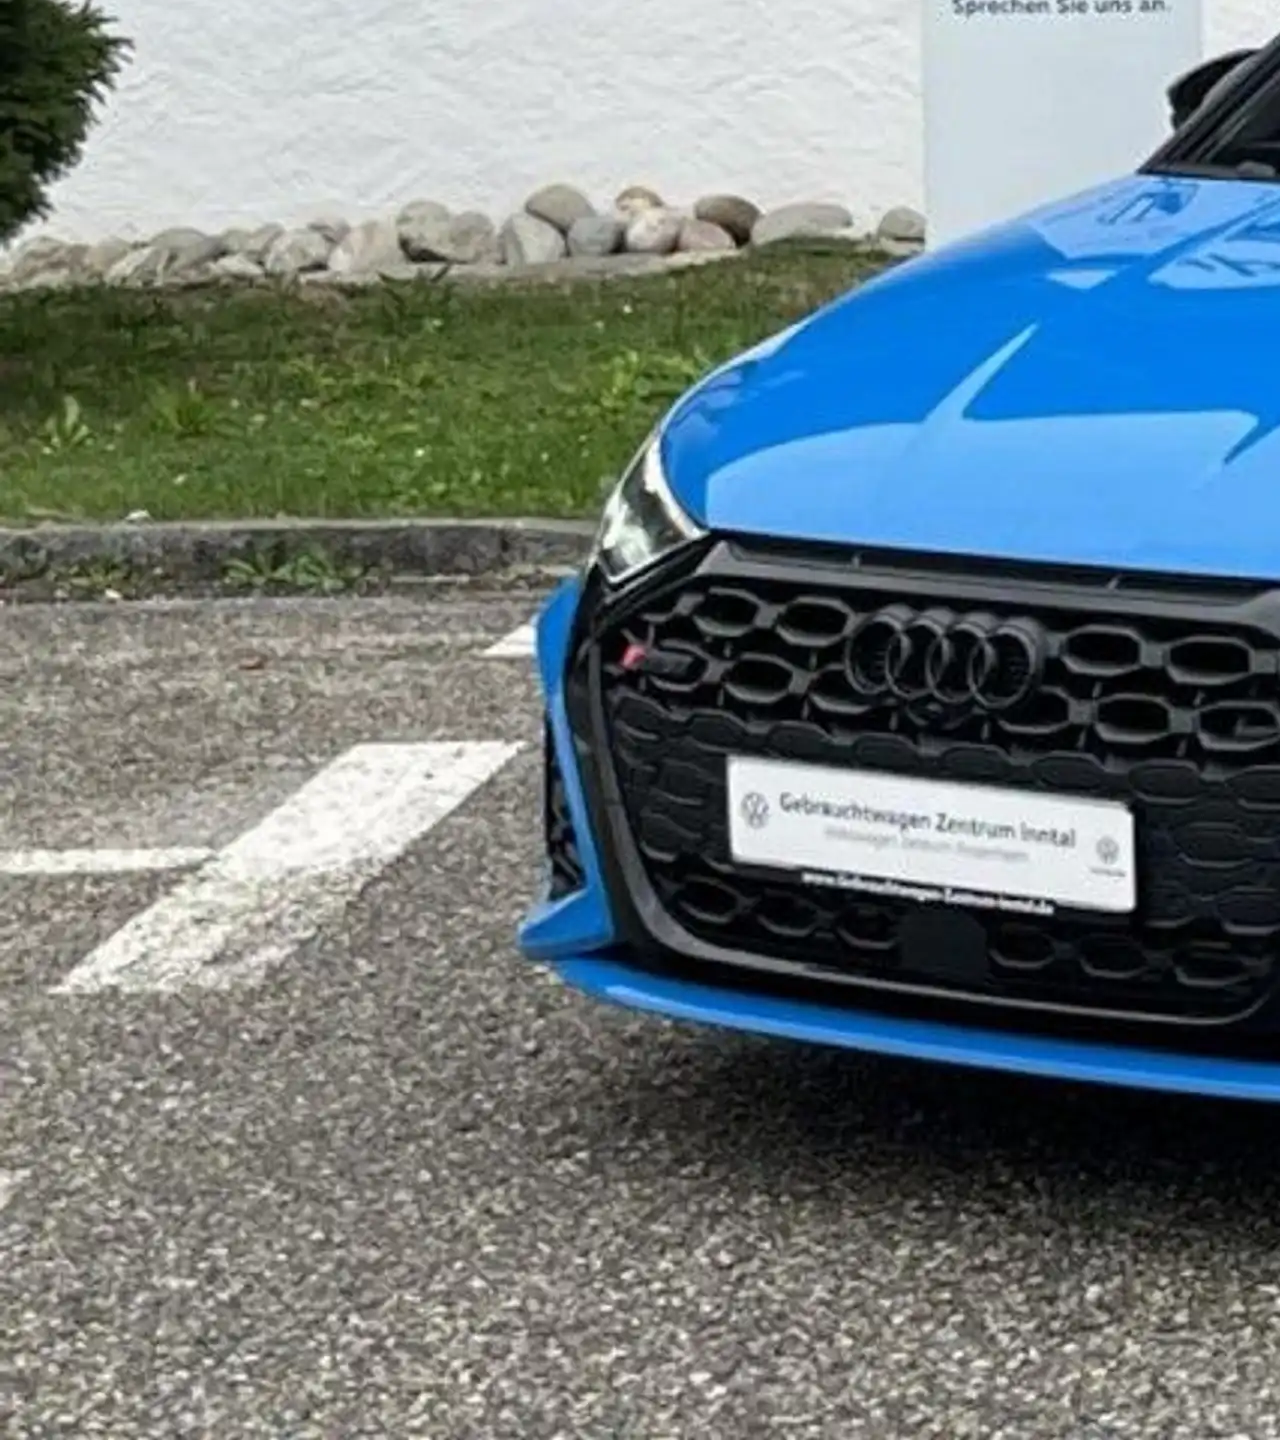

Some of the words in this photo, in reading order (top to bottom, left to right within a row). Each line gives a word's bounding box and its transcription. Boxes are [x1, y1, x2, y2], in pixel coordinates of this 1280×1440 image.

[1093, 0, 1133, 15] uns
[780, 791, 931, 832] Gebrauchtwagen
[935, 813, 1016, 839] Zentrum
[1020, 822, 1076, 848] Inntal
